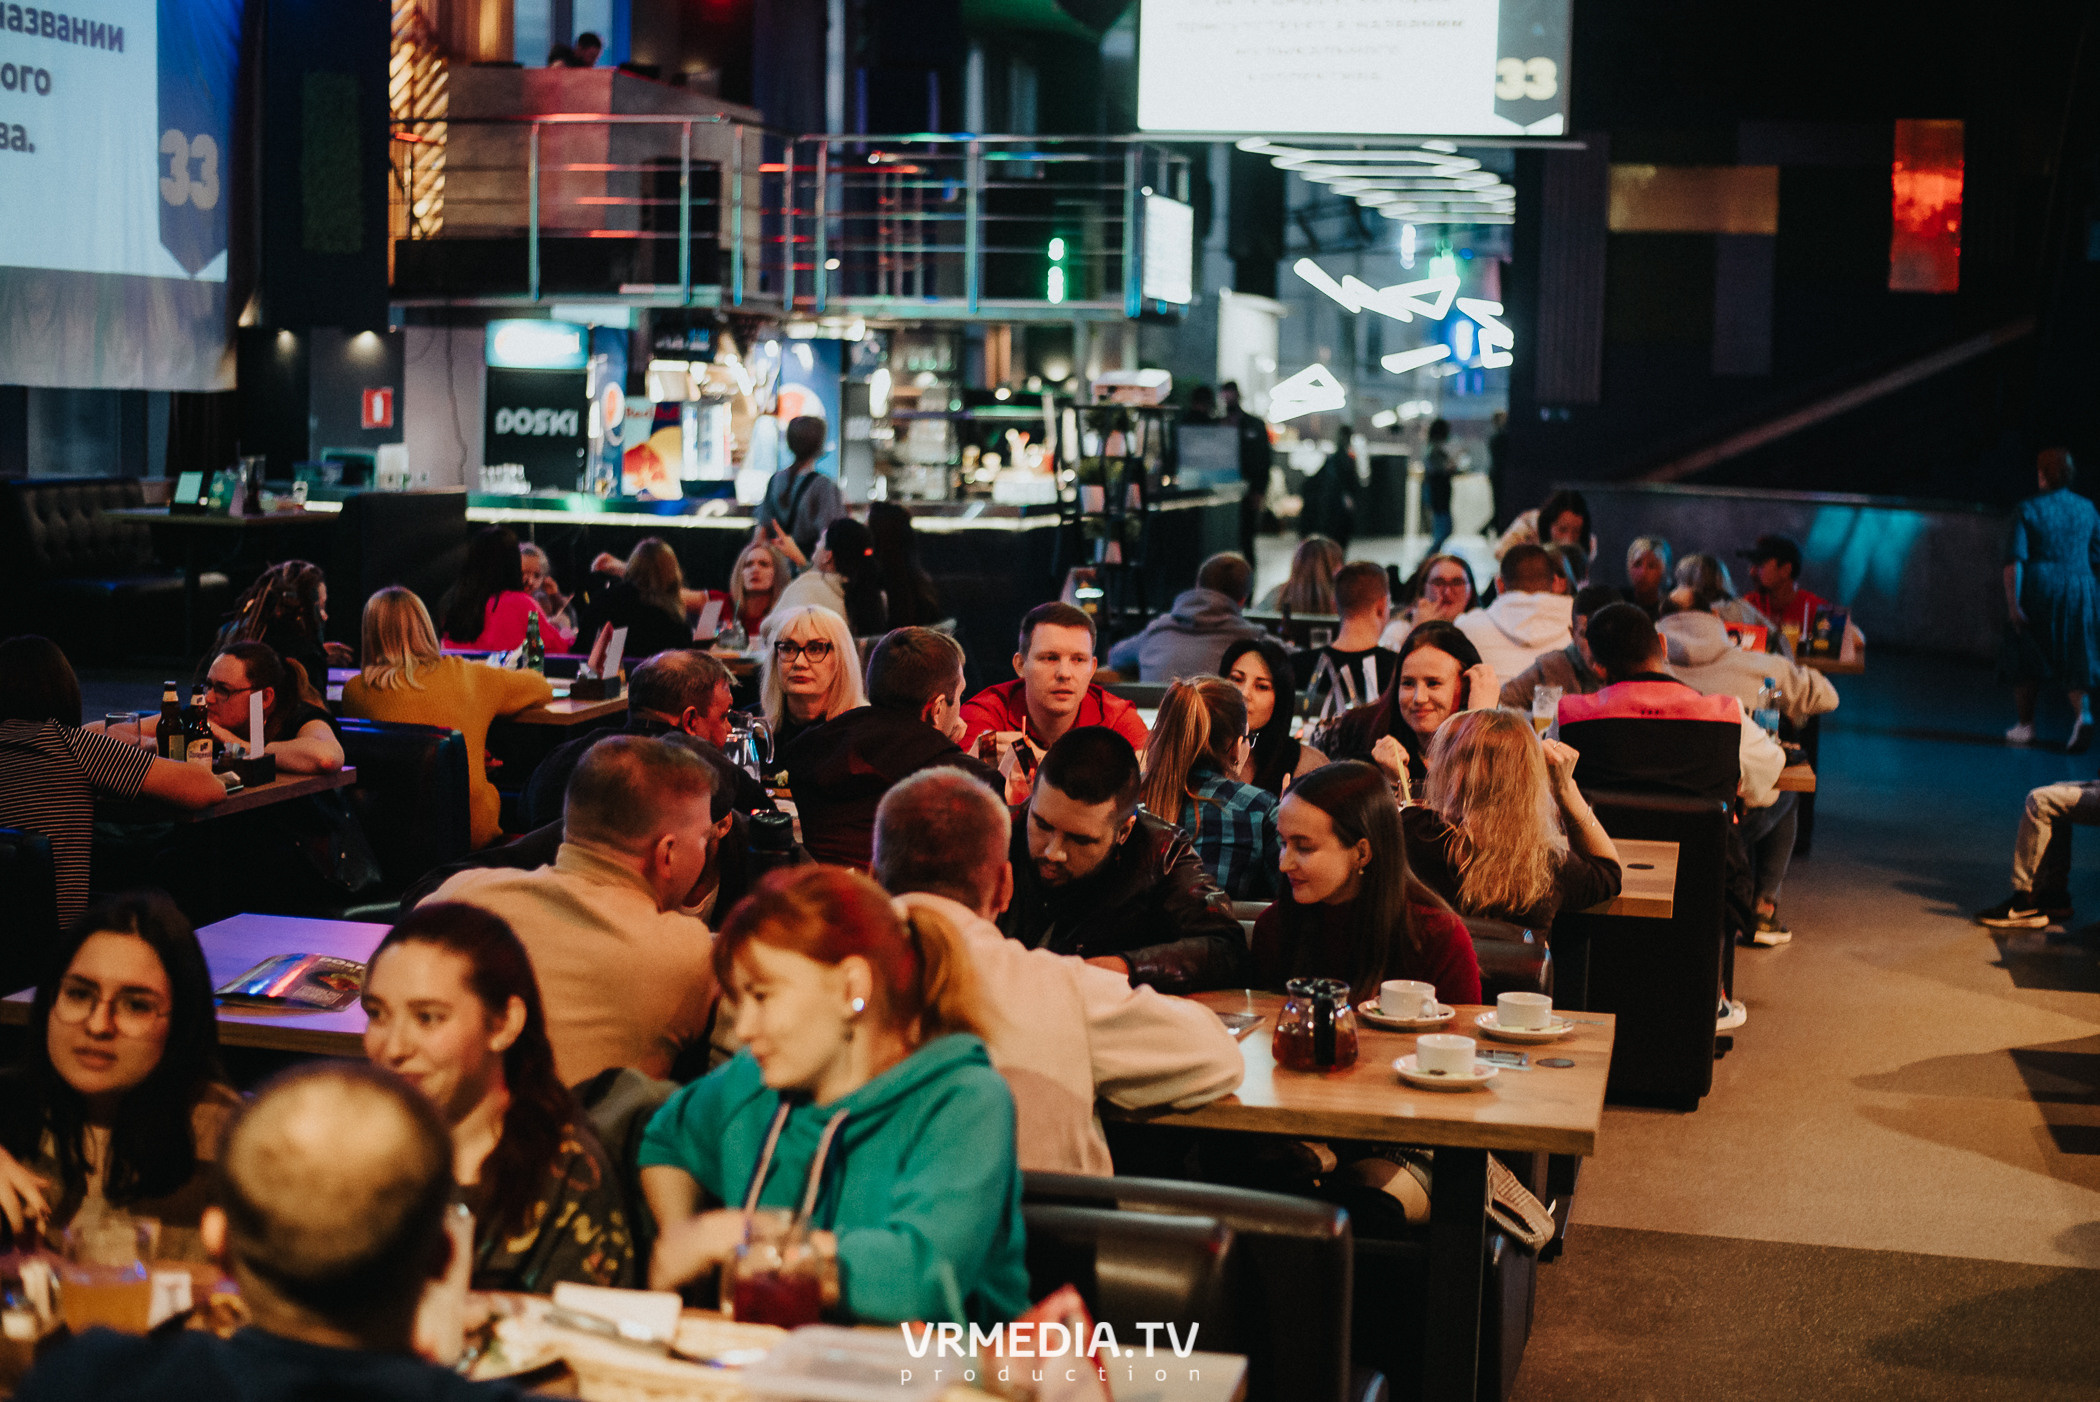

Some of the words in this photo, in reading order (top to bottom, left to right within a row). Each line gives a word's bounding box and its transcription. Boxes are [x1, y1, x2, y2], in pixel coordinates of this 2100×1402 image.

[1496, 57, 1558, 101] 33
[159, 128, 220, 210] 33
[495, 406, 579, 437] DOSKI
